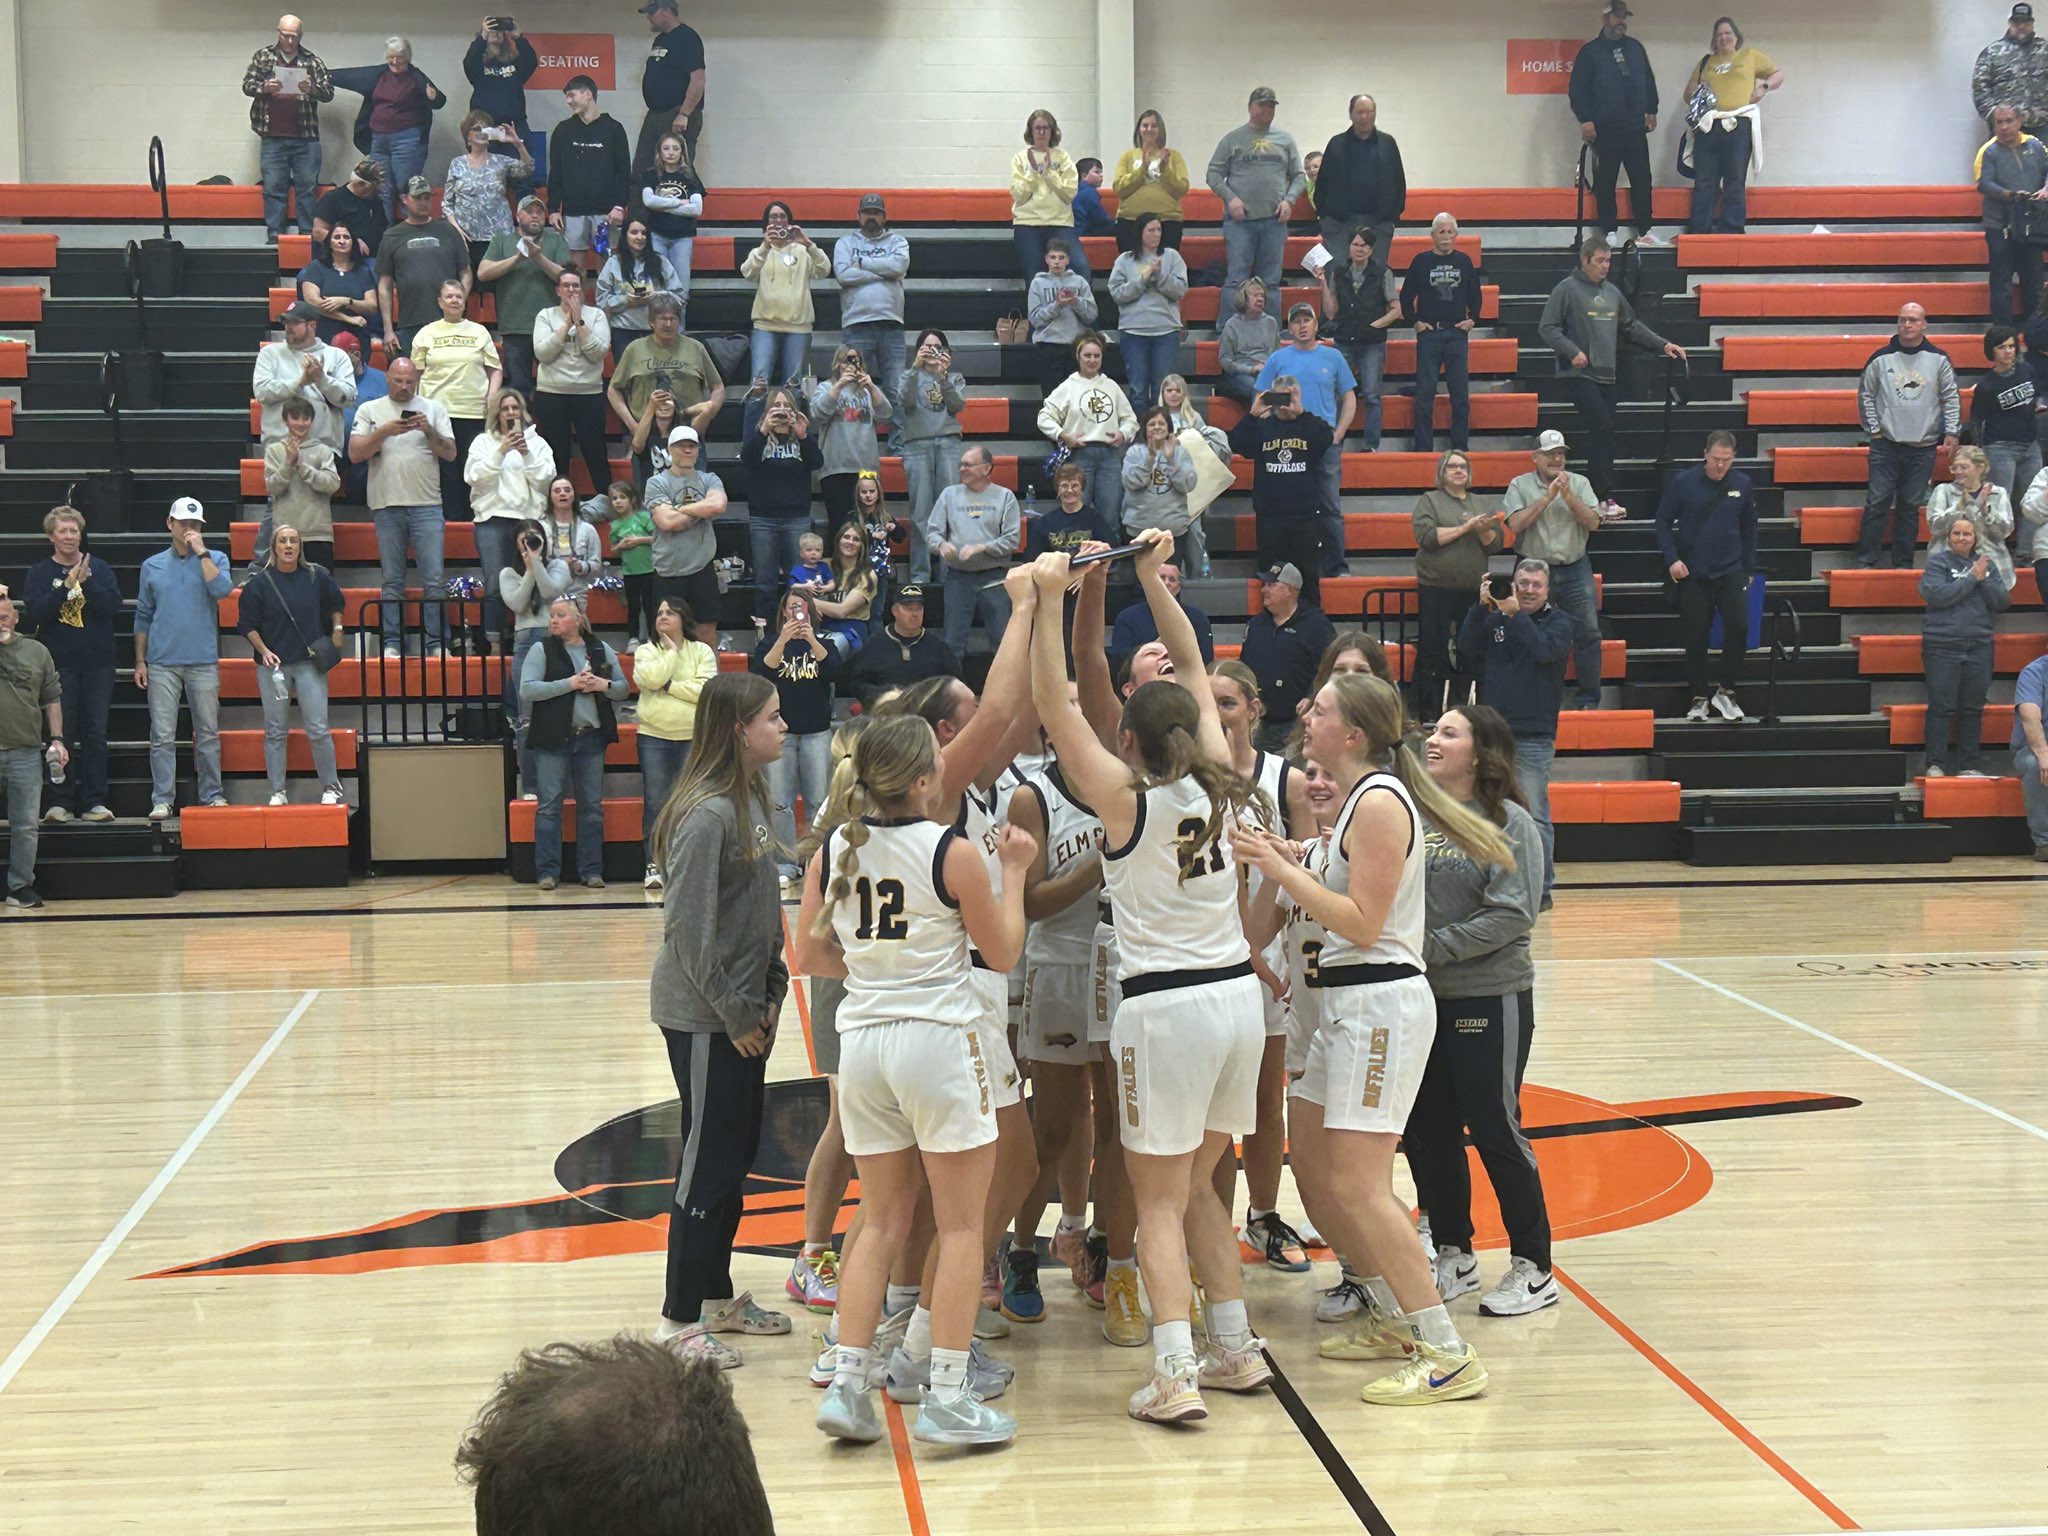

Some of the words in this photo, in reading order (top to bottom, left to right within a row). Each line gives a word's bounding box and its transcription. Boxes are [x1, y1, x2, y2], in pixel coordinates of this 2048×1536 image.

[539, 55, 600, 68] SEATING
[1522, 60, 1563, 73] HOME
[1056, 830, 1090, 867] ELM
[1176, 816, 1226, 880] 21
[855, 876, 909, 941] 12
